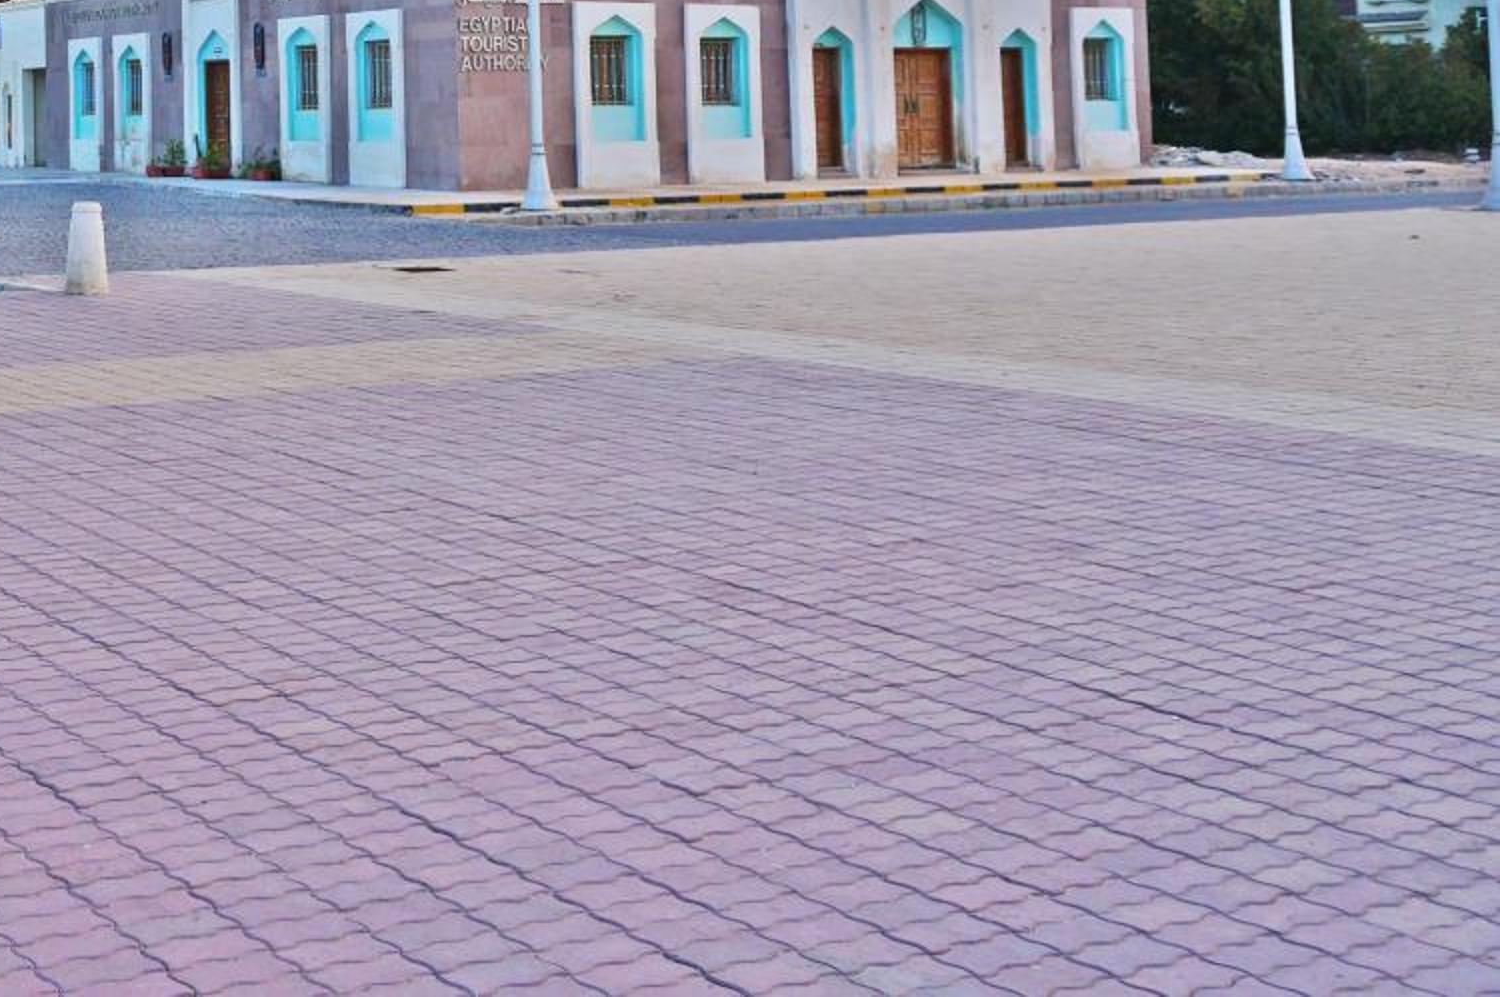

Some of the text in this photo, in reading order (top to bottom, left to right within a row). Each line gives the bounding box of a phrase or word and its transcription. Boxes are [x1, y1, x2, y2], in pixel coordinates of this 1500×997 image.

[459, 16, 528, 34] EGYPTIA
[461, 36, 528, 53] TOURIST
[461, 53, 549, 72] AUTHORY
